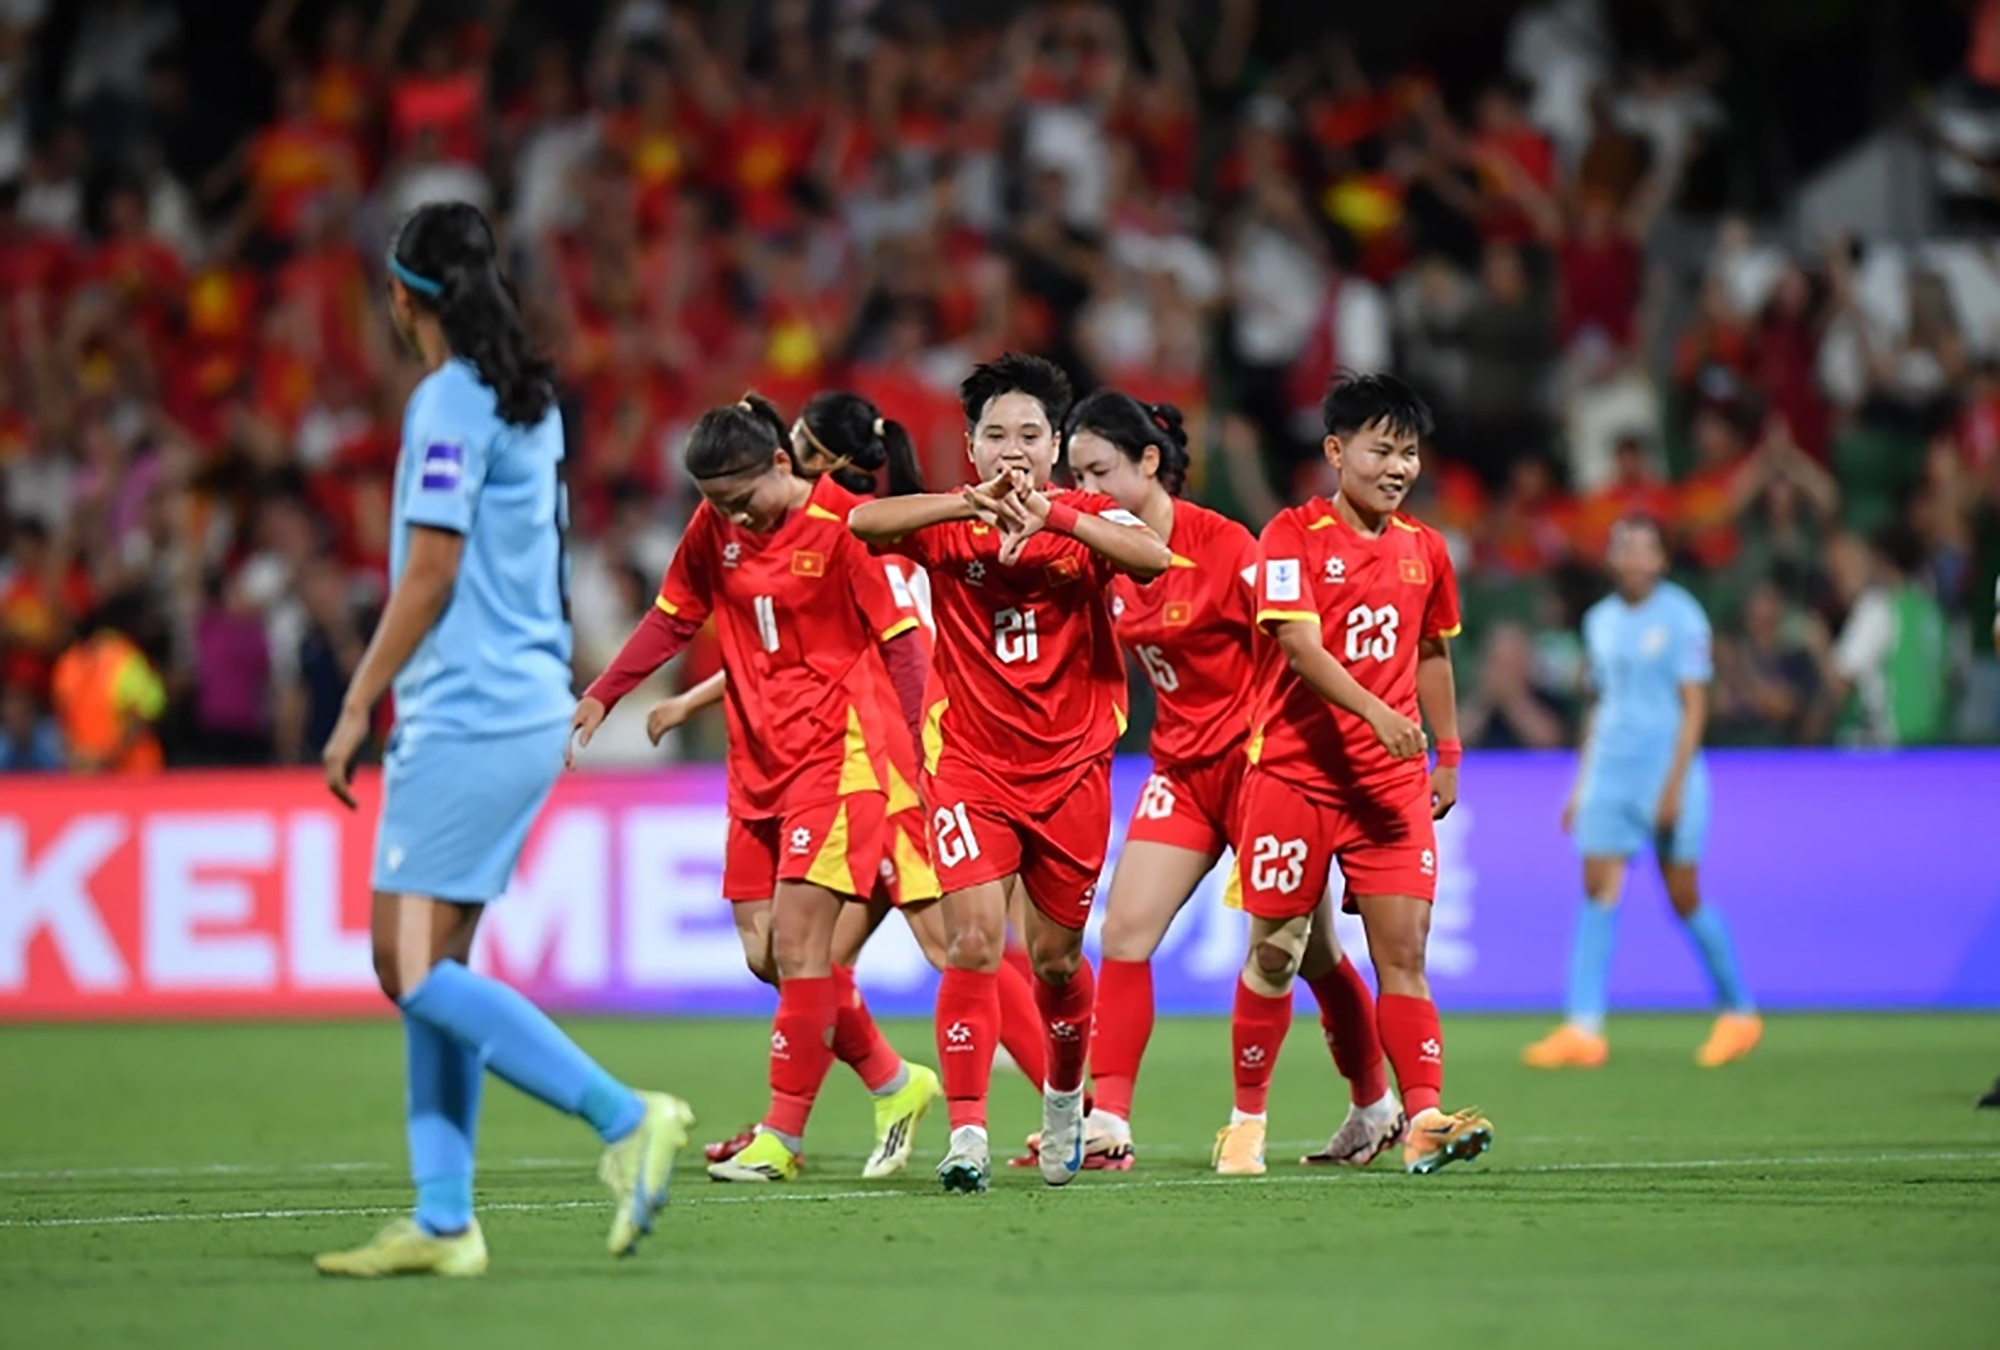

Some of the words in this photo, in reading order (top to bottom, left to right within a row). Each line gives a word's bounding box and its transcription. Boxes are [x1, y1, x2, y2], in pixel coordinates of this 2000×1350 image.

[753, 595, 780, 653] 11
[995, 608, 1039, 664] 21
[1344, 603, 1399, 662] 23
[1135, 644, 1180, 693] 15
[934, 801, 981, 868] 21
[1250, 834, 1308, 894] 23
